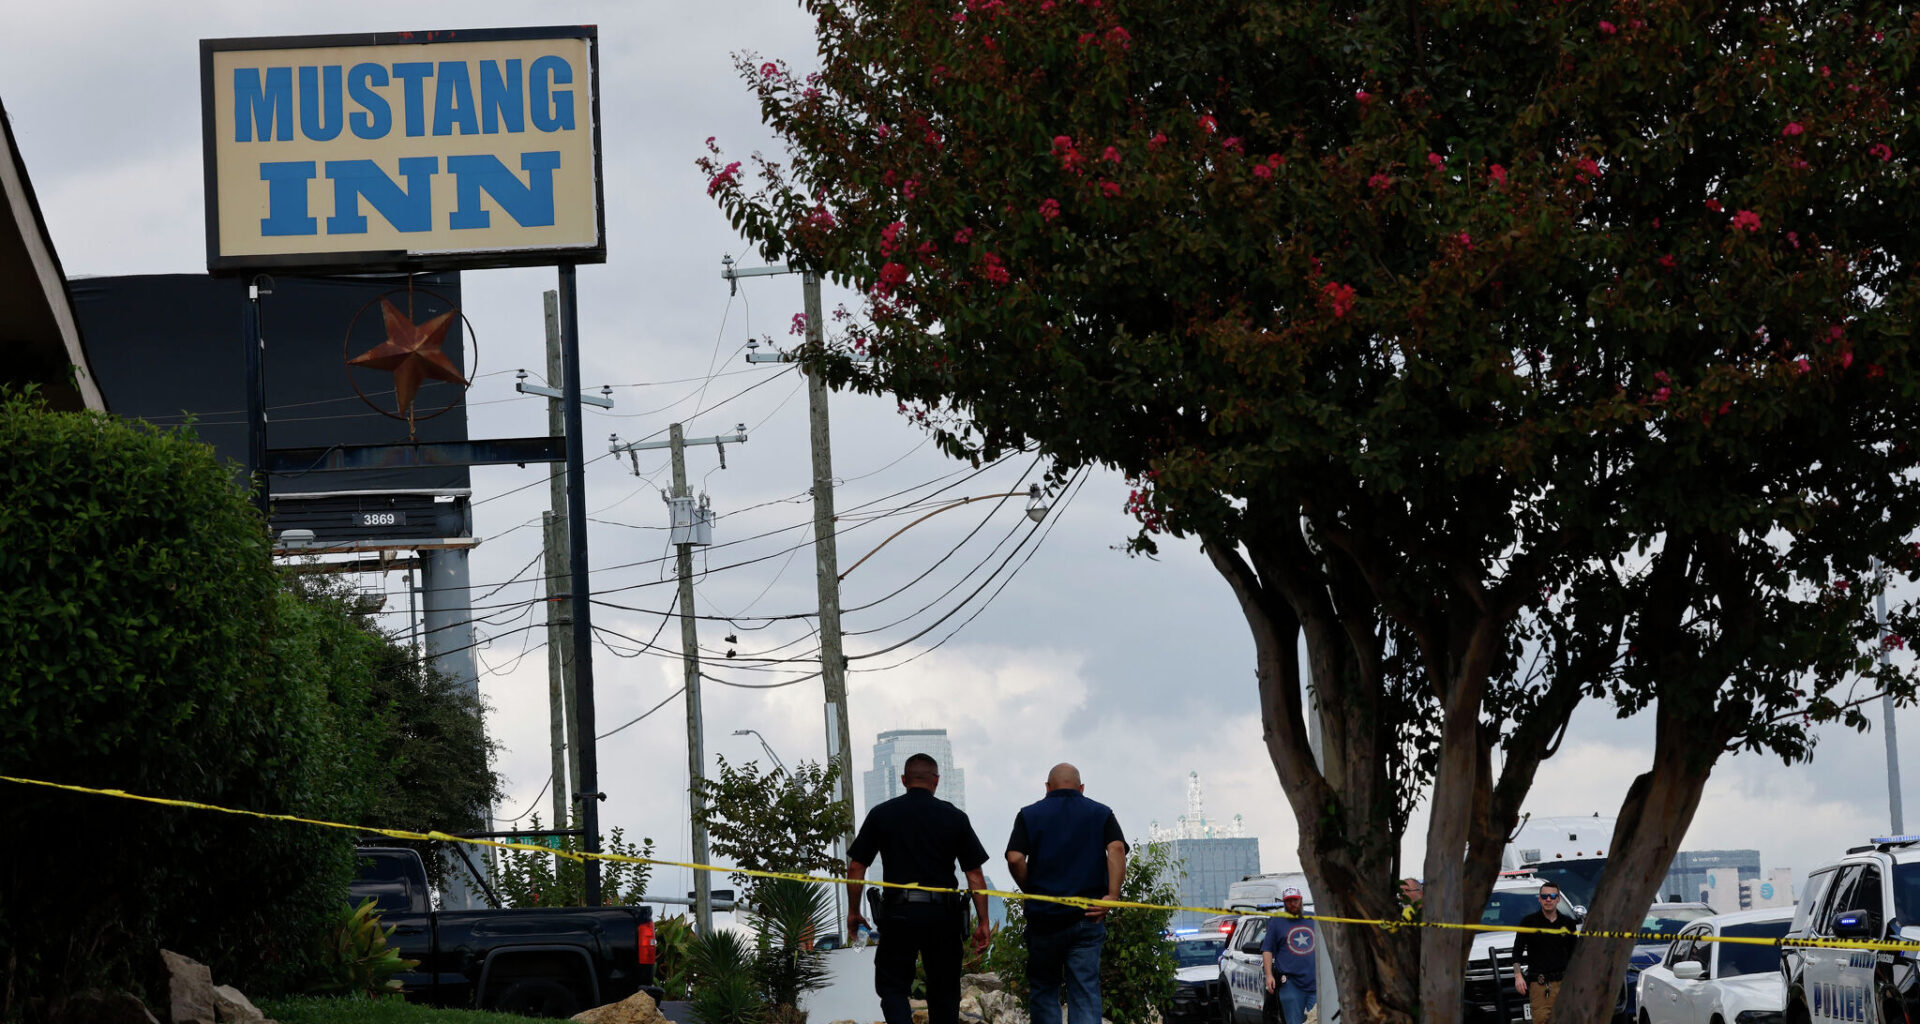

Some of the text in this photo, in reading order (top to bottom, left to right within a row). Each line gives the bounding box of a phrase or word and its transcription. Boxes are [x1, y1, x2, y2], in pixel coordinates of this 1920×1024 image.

[234, 55, 576, 142] MUSTANG
[259, 151, 561, 236] INN
[364, 513, 395, 525] 3869
[1813, 982, 1864, 1022] POLICE
